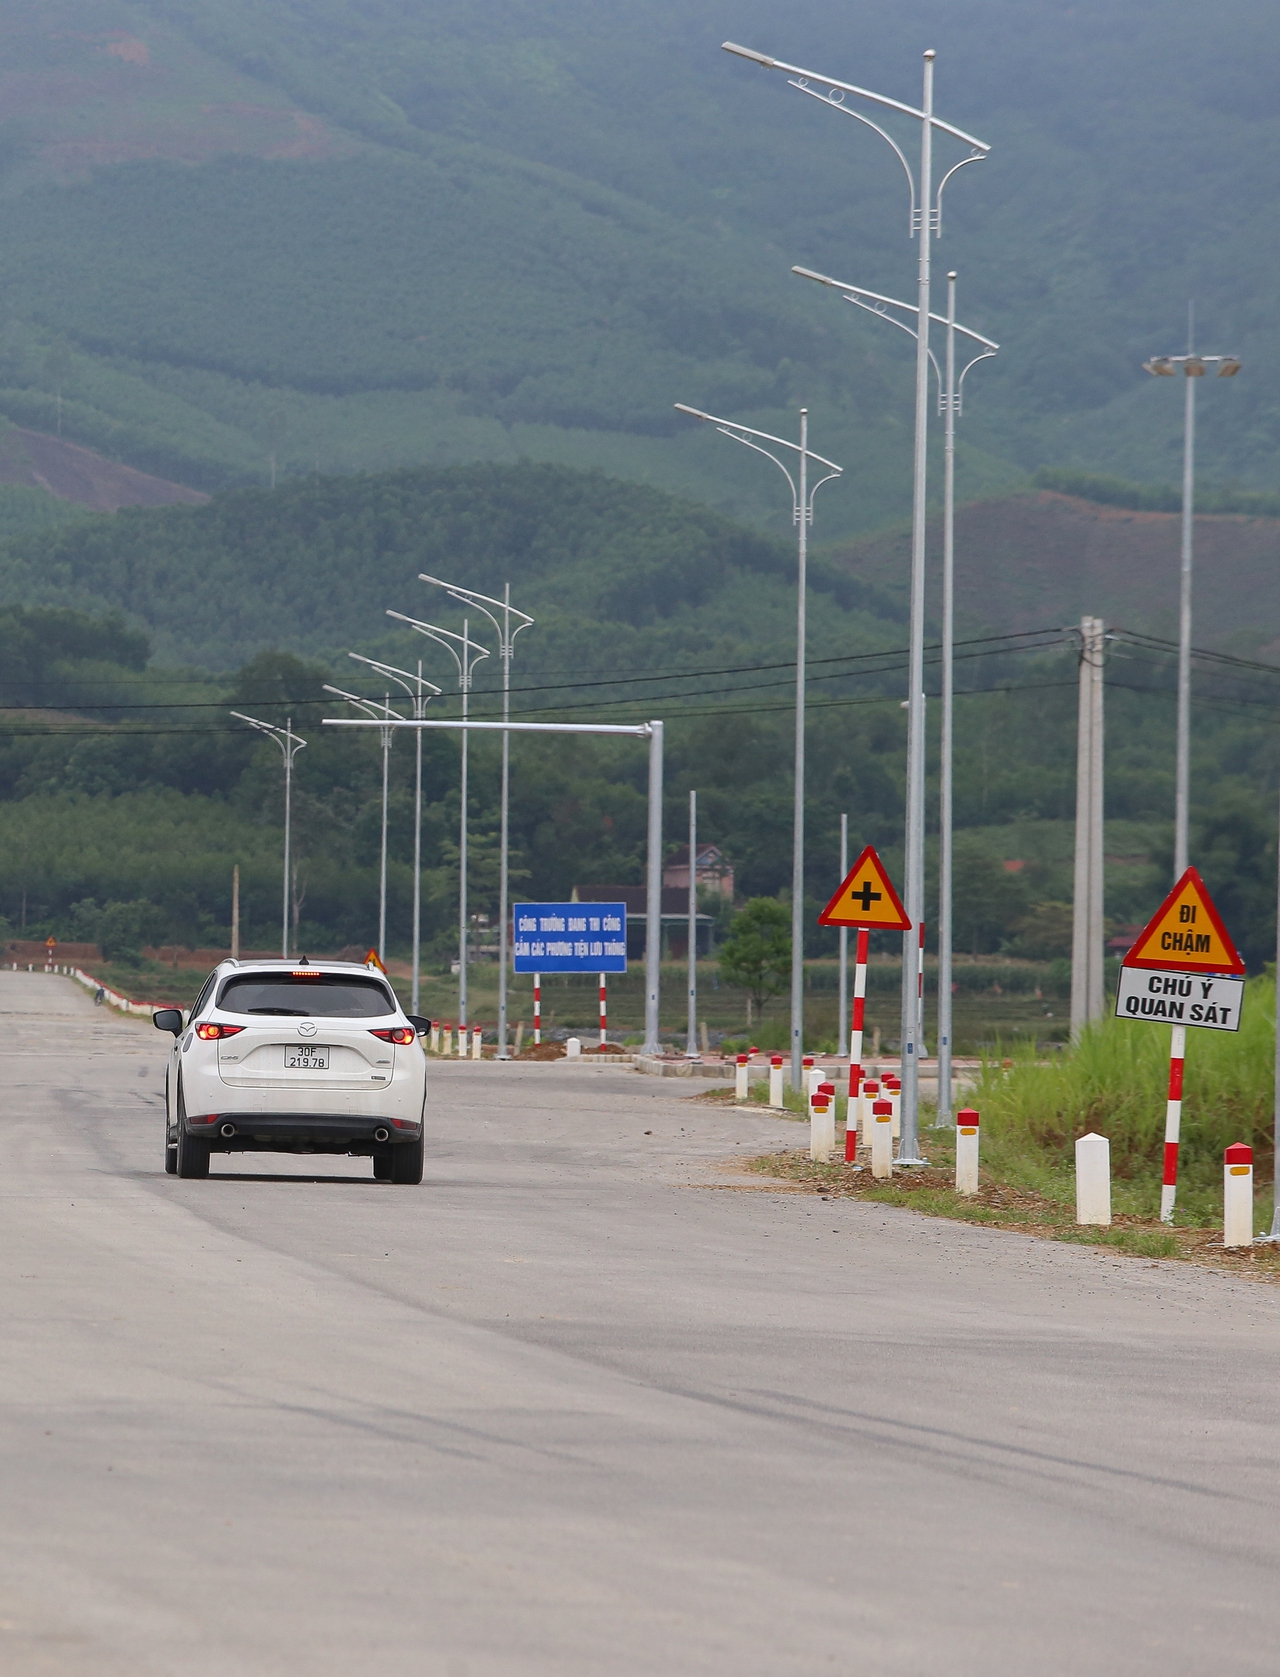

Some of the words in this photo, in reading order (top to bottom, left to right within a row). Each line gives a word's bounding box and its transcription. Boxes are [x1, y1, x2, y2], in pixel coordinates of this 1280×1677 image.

[519, 914, 537, 932] CÔNG
[588, 916, 600, 932] THI
[603, 914, 621, 932] CÔNG
[1179, 905, 1197, 924] ĐI
[1161, 929, 1211, 956] CHẬM
[1148, 975, 1193, 998] CHÚ
[1200, 978, 1214, 1000] Ý
[1125, 995, 1185, 1019] QUAN
[1189, 1001, 1232, 1025] SÁT
[297, 1047, 317, 1057] 30F
[289, 1057, 325, 1068] 219.78
